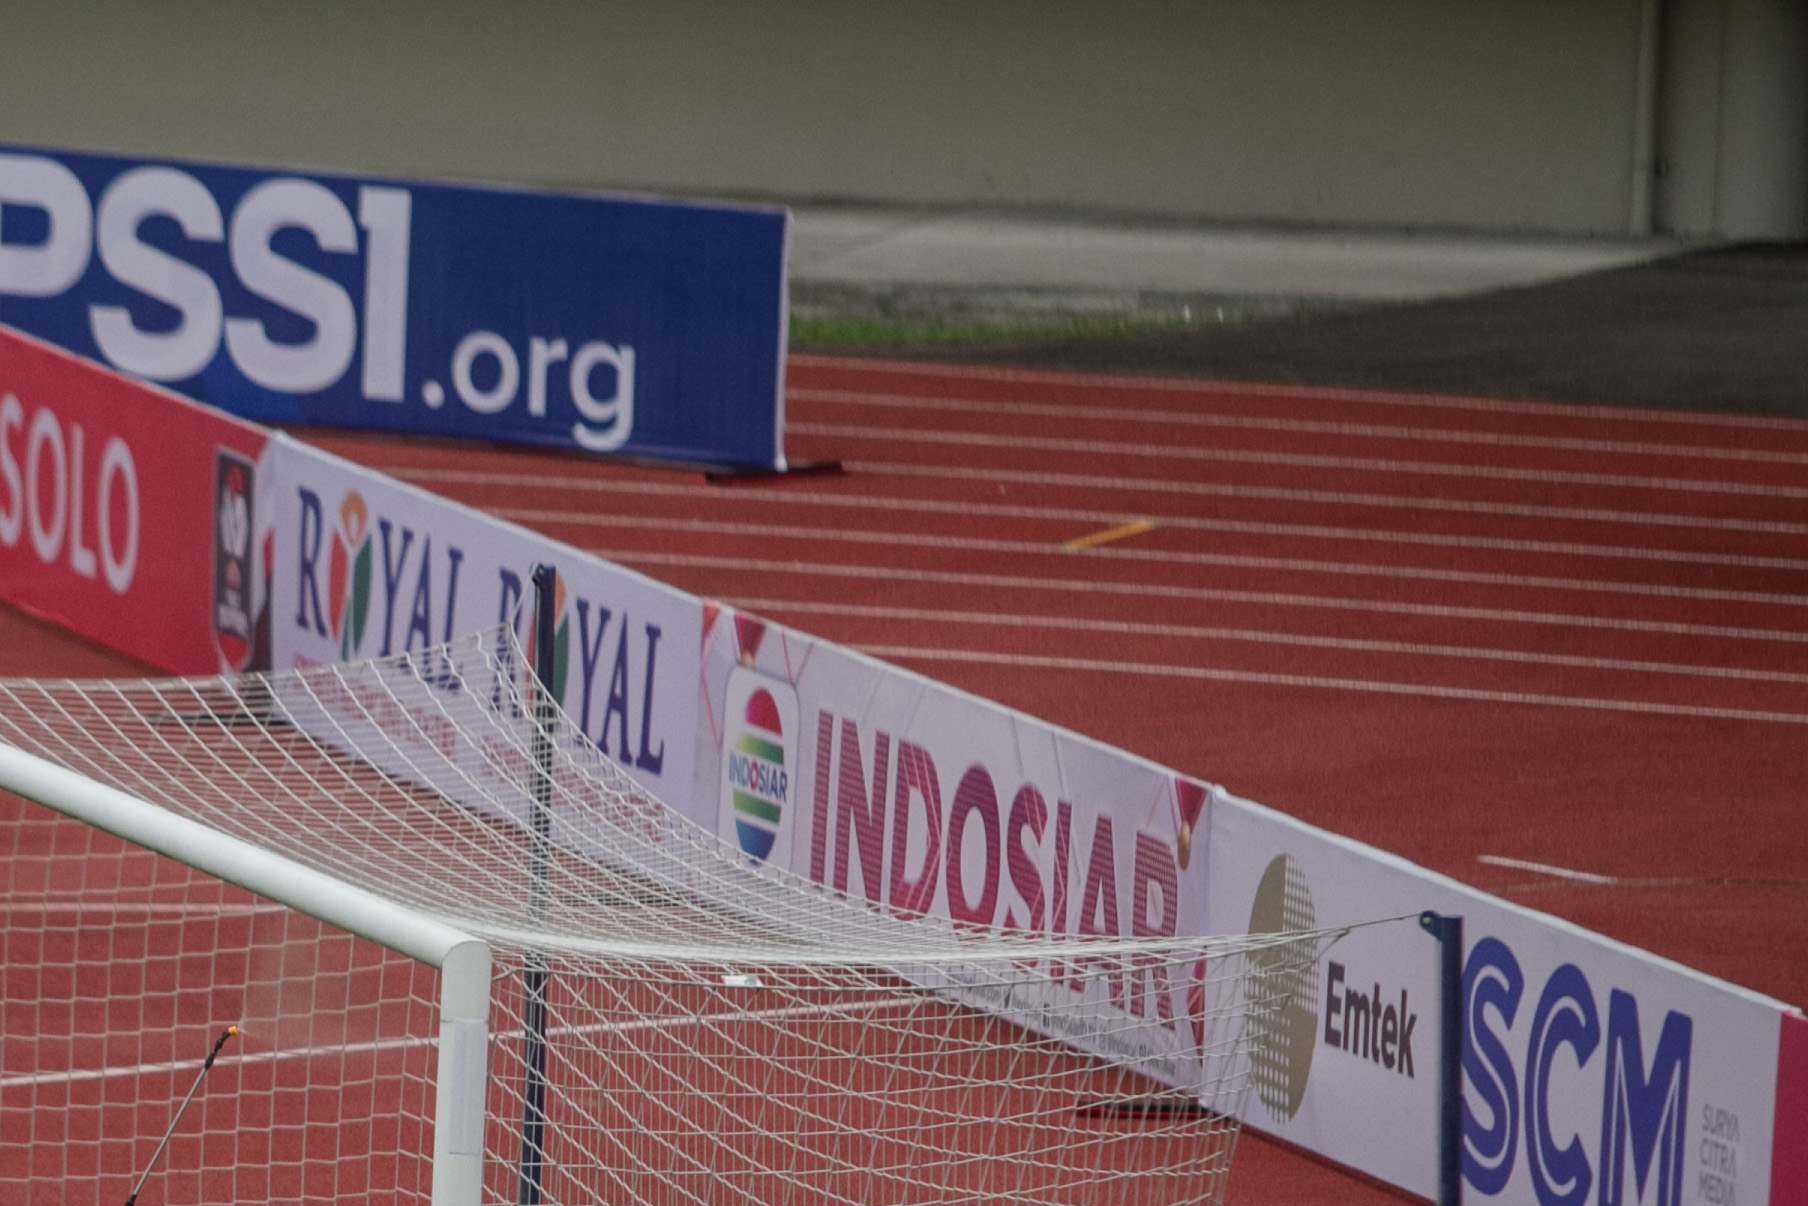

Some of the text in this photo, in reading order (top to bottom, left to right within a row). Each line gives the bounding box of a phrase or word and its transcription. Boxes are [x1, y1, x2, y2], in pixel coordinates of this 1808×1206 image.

[491, 567, 665, 776] RYAL
[728, 751, 789, 804] INDOSIAR
[810, 708, 1179, 1033] INDOSIAR
[1324, 960, 1418, 1079] Emtek
[1699, 1137, 1738, 1179] CITRA
[1701, 1103, 1741, 1143] SURYA
